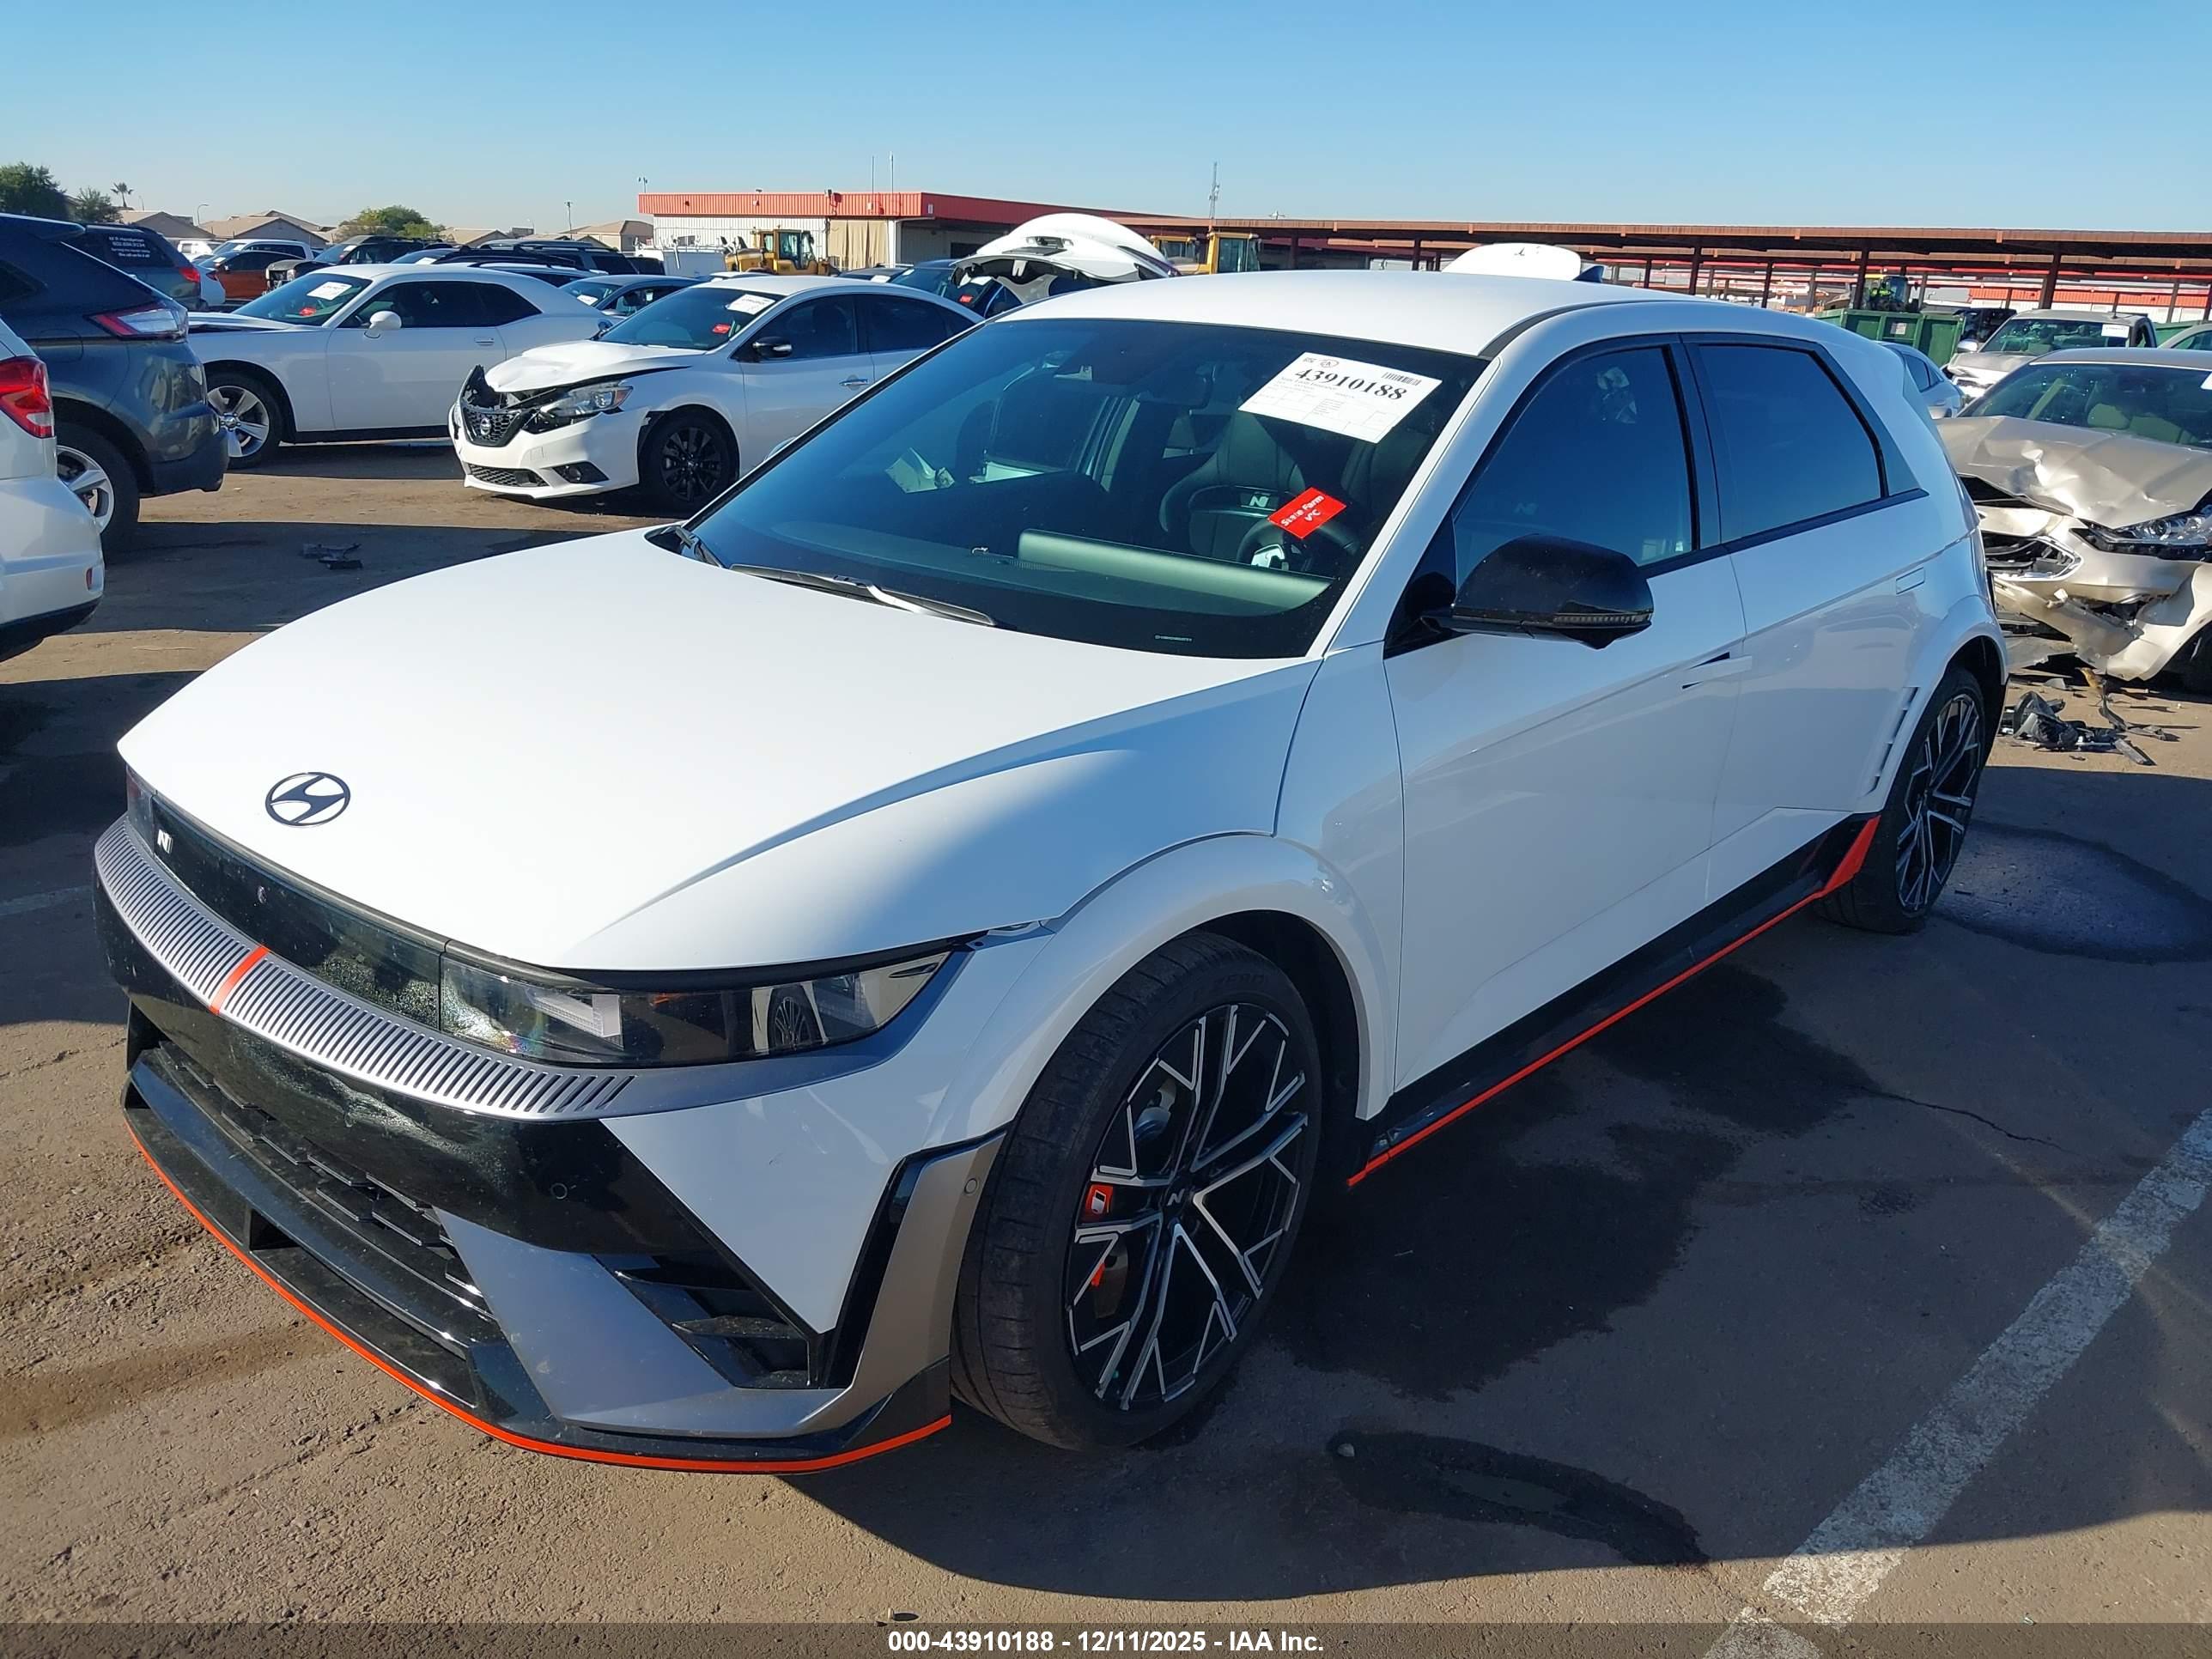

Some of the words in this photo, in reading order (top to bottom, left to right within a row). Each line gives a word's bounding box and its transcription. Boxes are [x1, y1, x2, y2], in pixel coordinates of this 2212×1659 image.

[1295, 368, 1407, 400] 43910188
[1280, 509, 1304, 526] State
[1302, 495, 1325, 510] Farm
